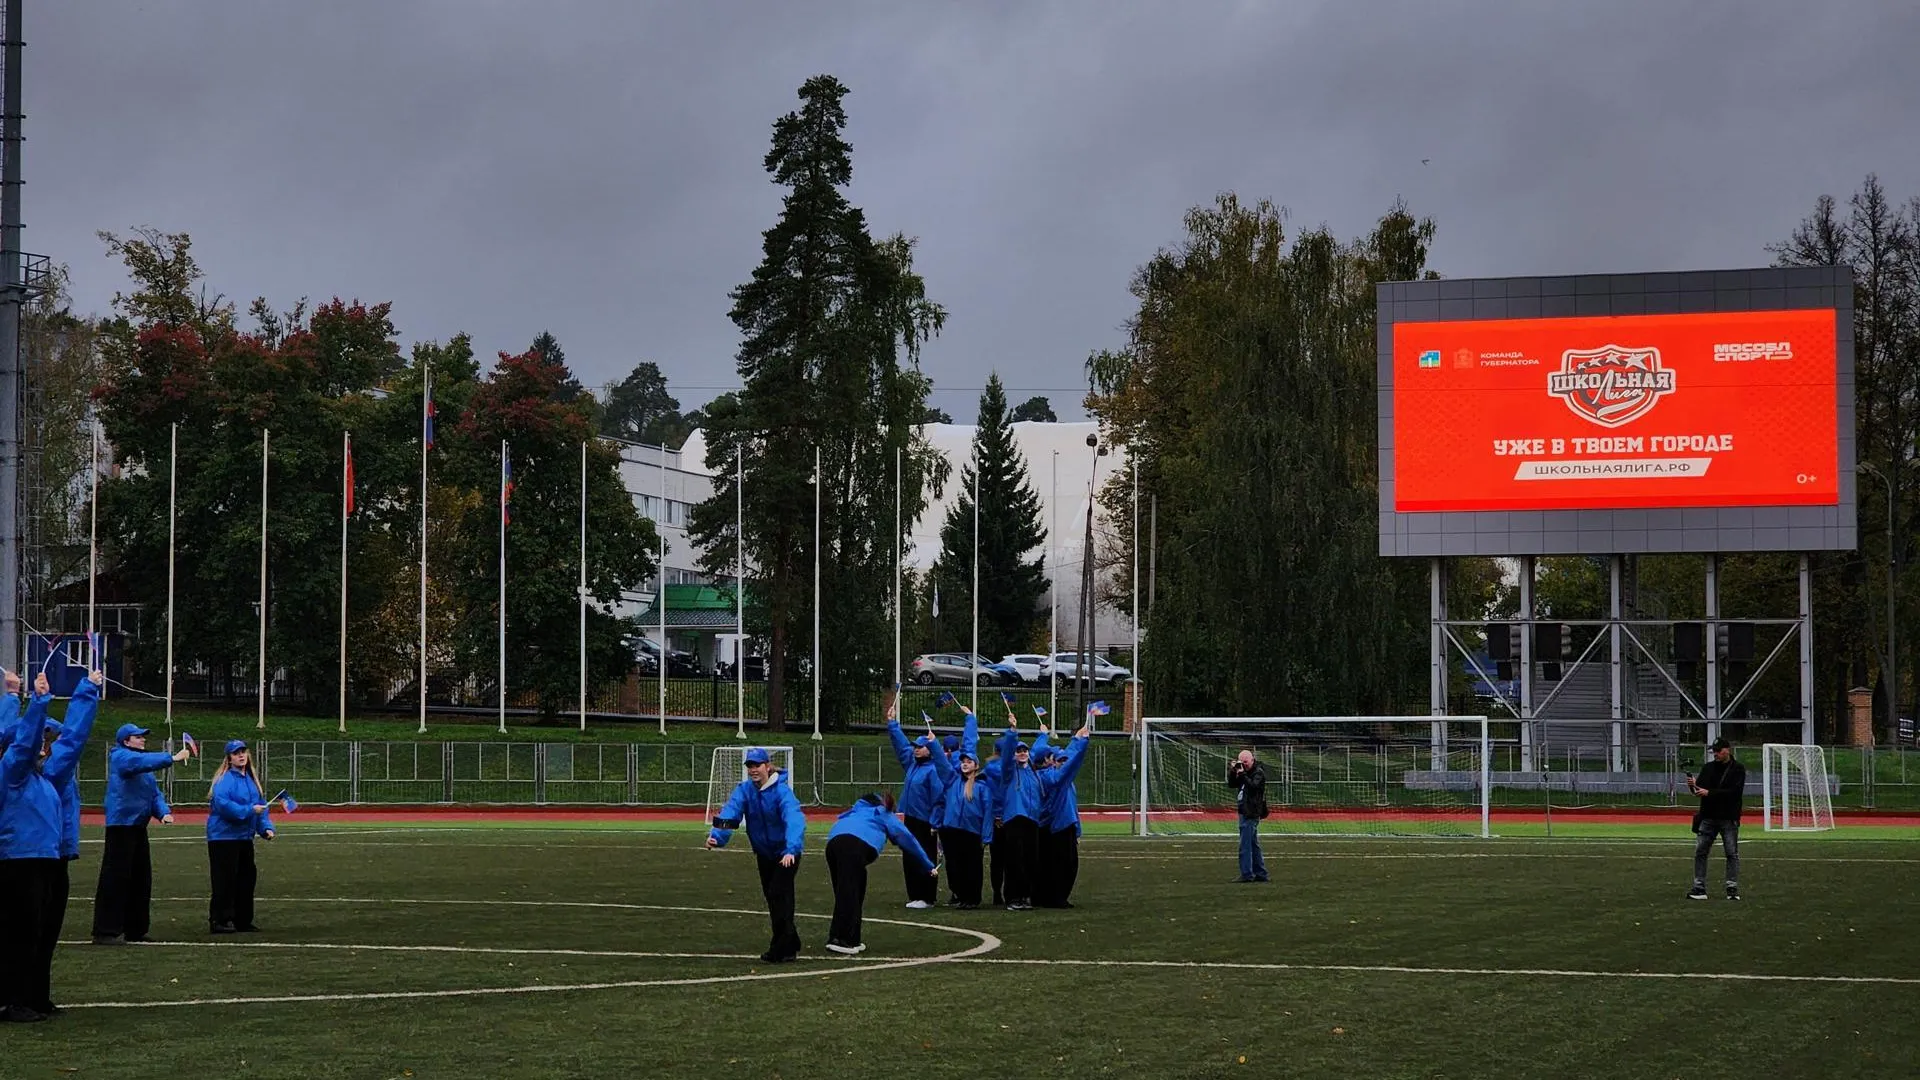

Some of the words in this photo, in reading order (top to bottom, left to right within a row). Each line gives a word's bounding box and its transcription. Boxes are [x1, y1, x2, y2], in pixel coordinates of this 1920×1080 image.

[1713, 342, 1791, 353] МОСОБЛ
[1480, 351, 1523, 359] КОМАНДА
[1713, 352, 1774, 361] СПОРТ
[1480, 359, 1540, 367] ГУБЕРНАТОРА
[1553, 370, 1671, 392] ШКОЛЬНАЯ
[1493, 438, 1545, 456] УЖЕ
[1551, 438, 1565, 455] В
[1571, 436, 1644, 454] ТВОЕМ
[1650, 434, 1734, 453] ГОРОДЕ
[1534, 462, 1691, 475] ШКОЛЬНАЯЛИГА.РФ
[1796, 473, 1817, 484] 0+
